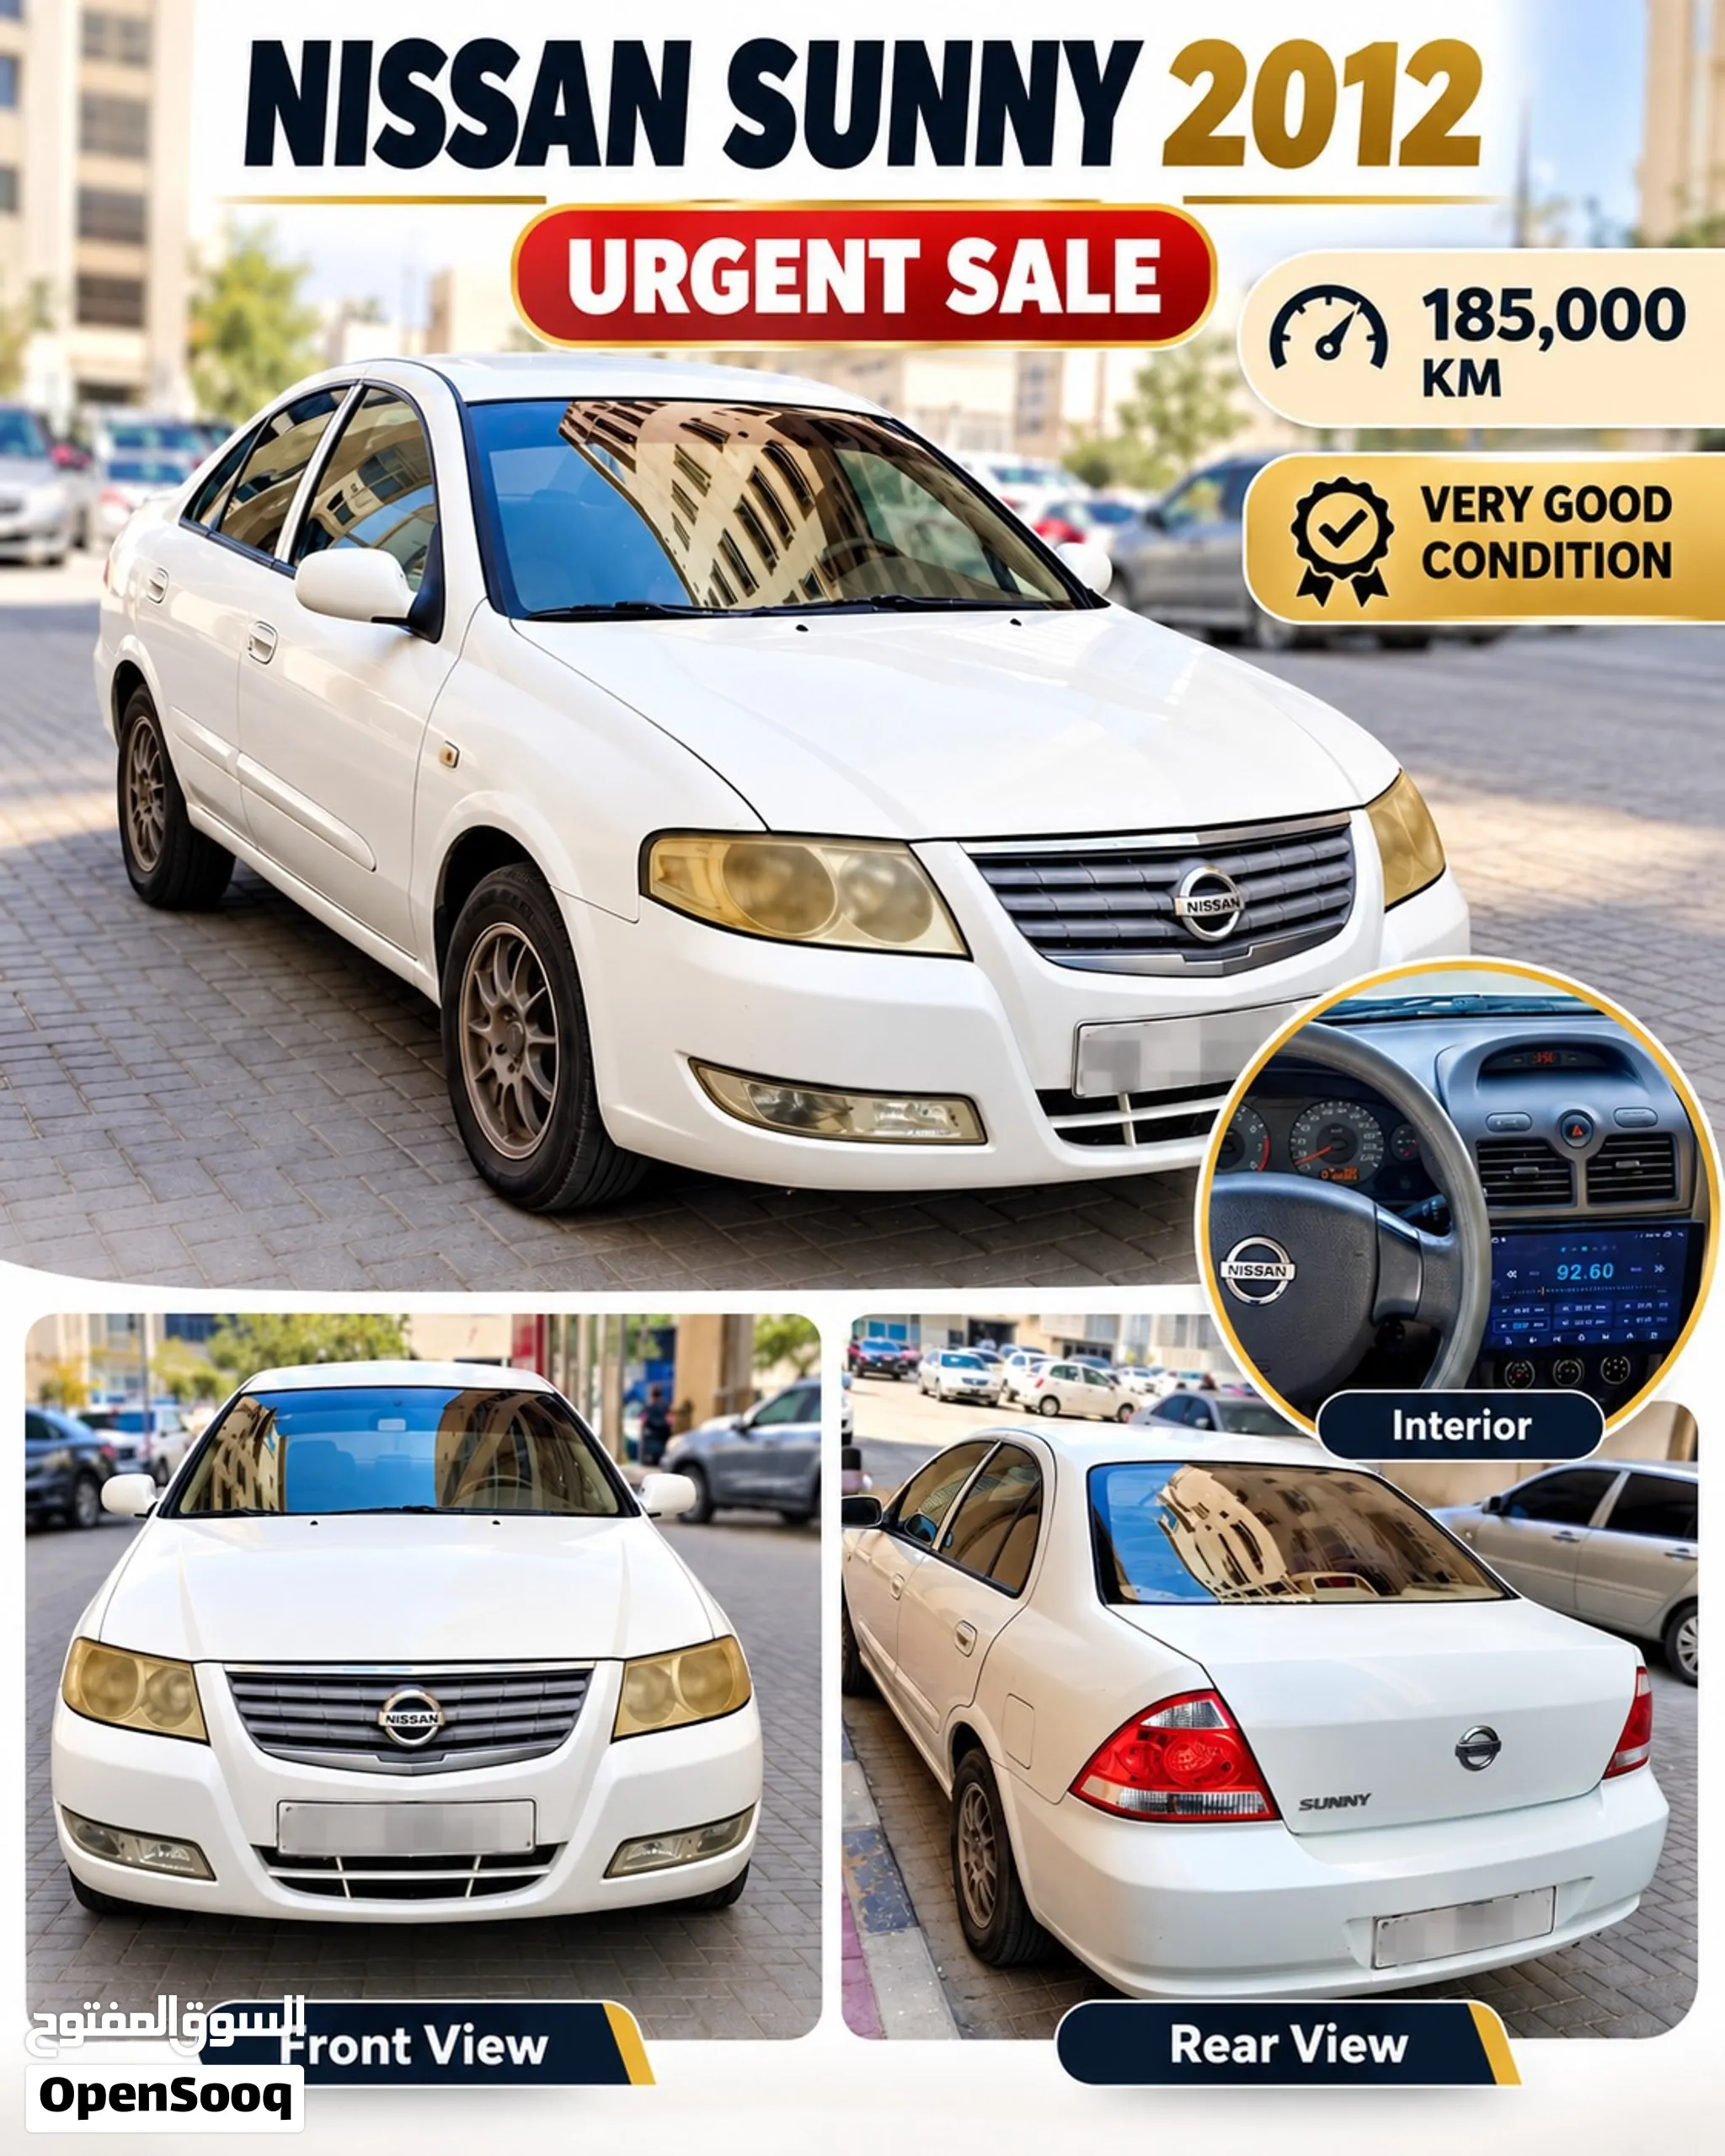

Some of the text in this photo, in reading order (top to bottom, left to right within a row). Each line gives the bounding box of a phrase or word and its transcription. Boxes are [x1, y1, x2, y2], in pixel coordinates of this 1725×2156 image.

[1186, 896, 1241, 913] NISSAN
[1228, 1265, 1286, 1277] NISSAN
[1557, 1262, 1614, 1281] 92.60
[385, 1714, 439, 1725] NISSAN
[1298, 1792, 1372, 1811] SUNNY
